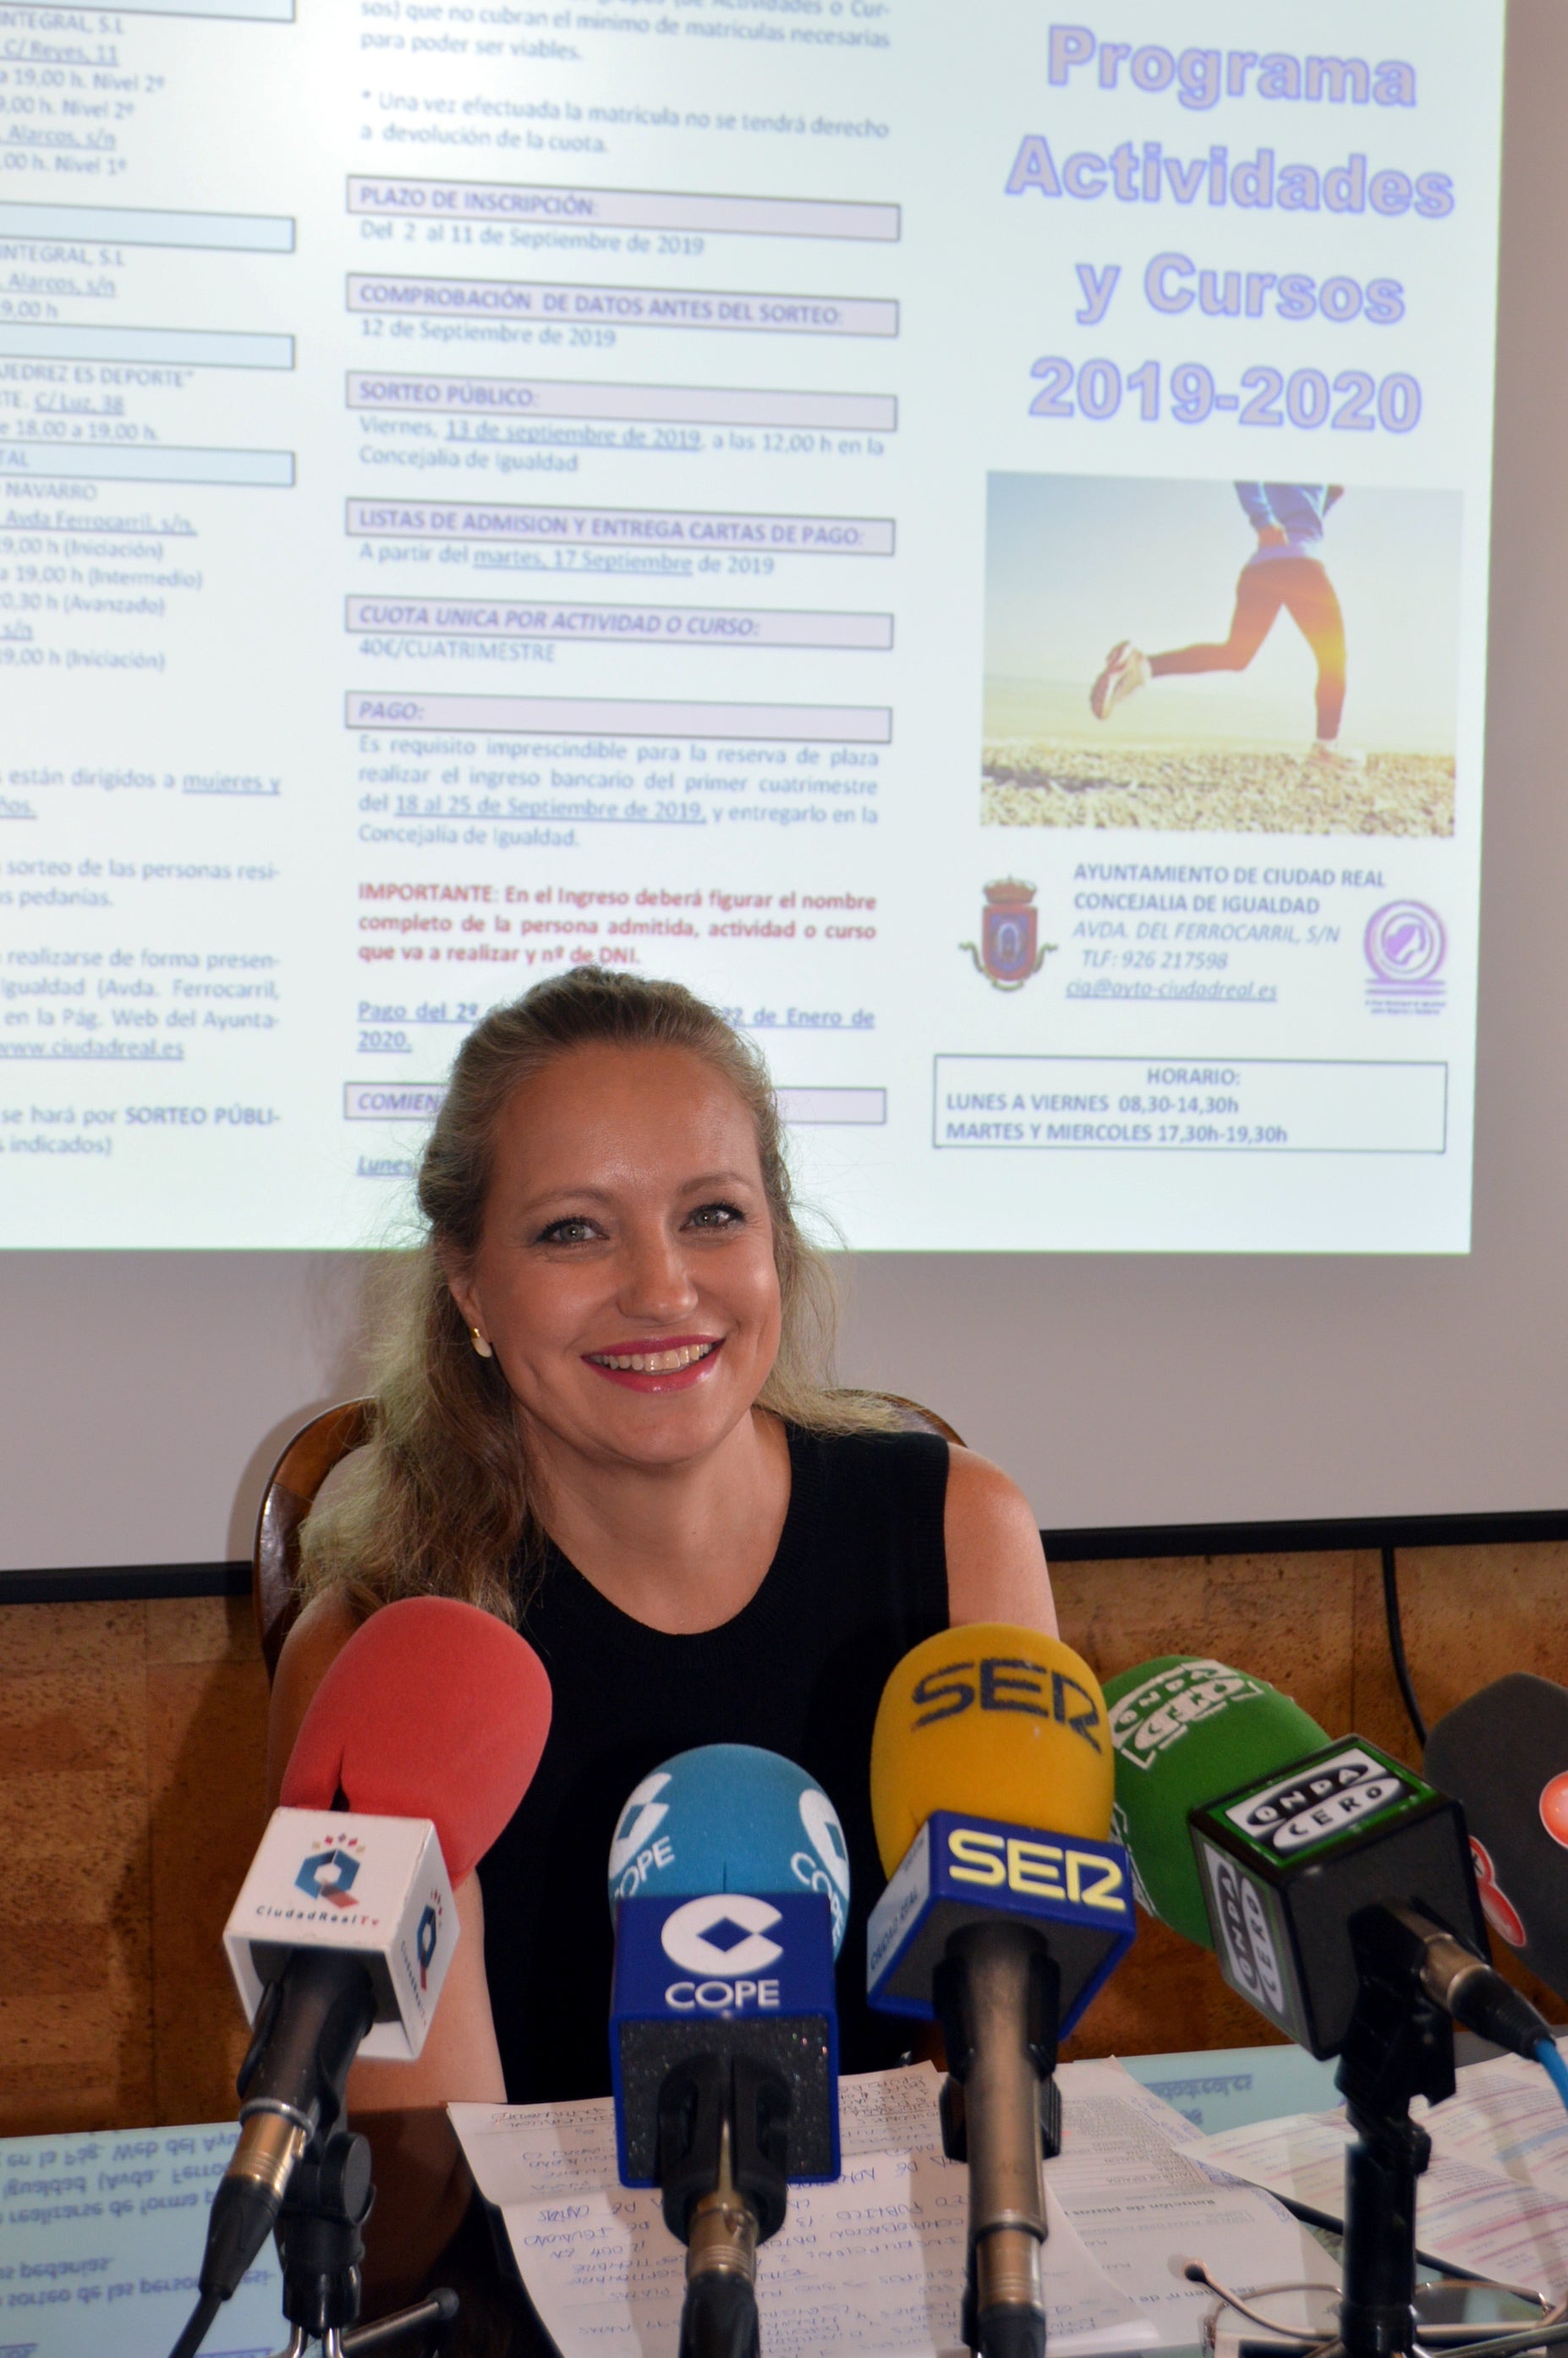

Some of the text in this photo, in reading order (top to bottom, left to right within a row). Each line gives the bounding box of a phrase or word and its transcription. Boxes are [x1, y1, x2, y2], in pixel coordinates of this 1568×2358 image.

[1047, 24, 1417, 111] Programa
[1005, 134, 1456, 219] Actividades
[359, 186, 600, 215] PLAZO DE INSCRIPCIÓN:
[360, 220, 705, 255] Del 2 al 11 de Septiembre de 2019
[1074, 251, 1406, 326] y Cursos
[359, 285, 847, 324] COMPROBACIÓN DE DATOS ANTES DEL SORTEO:
[360, 317, 617, 347] 12 de Septiembre de 2019
[359, 381, 540, 407] SORTEO PÚBLICO:
[1028, 355, 1423, 435] 2019-2020
[5, 482, 97, 500] NAVARRO
[359, 509, 866, 545] LISTAS DE ADMISION Y ENTREGA CARTAS DE PAGO:
[15, 565, 203, 588] 19,00 h (Intermedio)
[359, 605, 761, 635] CUOTA UNICA POR ACTIVIDAD O CURSO:
[359, 638, 554, 661] 40€/CUATRIMESTRE
[359, 701, 424, 720] PAGO:
[358, 825, 578, 847] Concejalía de Igualdad.
[1073, 864, 1384, 887] AYUNTAMIENTO DE CIUDAD REAL
[358, 883, 876, 910] IMPORTANTE: En el Ingreso deberá figurar el nombre
[1073, 892, 1320, 914] CONCEJALIA DE IGUALDAD
[358, 916, 876, 940] completo de la persona admitida, actividad o curso
[1072, 920, 1340, 943] AVDA. DEL FERROCARRIL, S/N
[358, 946, 639, 966] que va a realizar y nº de DNI.
[1083, 949, 1228, 970] TLF: 926 217598
[3, 1008, 279, 1030] en la Pág. Web del Ayunta-
[358, 1002, 875, 1030] Pago del 2º de Enero de
[359, 1031, 412, 1053] 2020.
[1146, 1068, 1241, 1086] HORARIO:
[357, 1093, 441, 1110] COMIEN
[946, 1094, 1239, 1114] LUNES A VIERNES 08,30-14,30h
[1, 1106, 280, 1126] se hará por SORTEO PÚBLI-
[946, 1122, 1287, 1143] MARTES Y MIERCOLES 17,30h-19,30h
[357, 1155, 414, 1176] Lunes
[910, 1658, 1103, 1755] SER
[1253, 1766, 1362, 1823] ONDA
[1286, 1784, 1384, 1838] CERO
[615, 1834, 676, 1899] OPE
[947, 1828, 1127, 1913] SER
[665, 1978, 781, 2010] COPE
